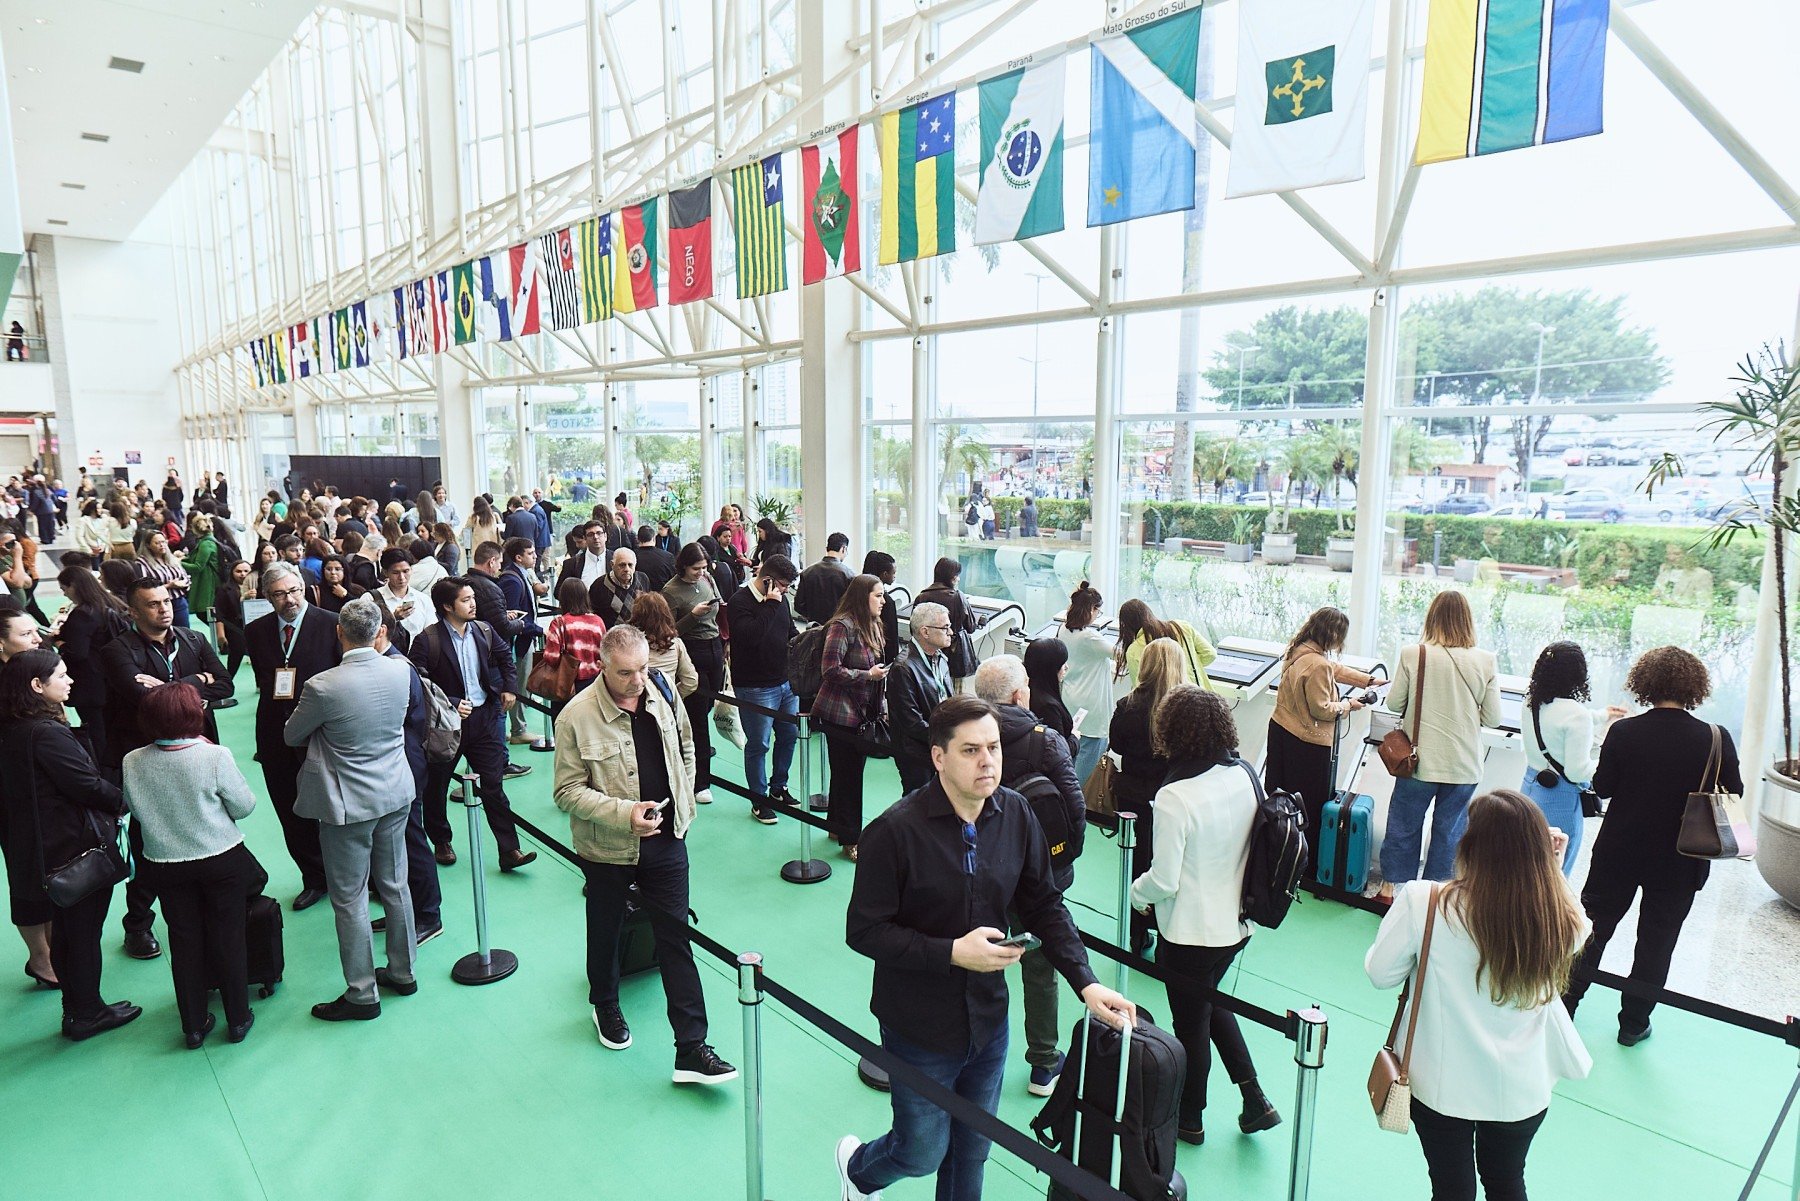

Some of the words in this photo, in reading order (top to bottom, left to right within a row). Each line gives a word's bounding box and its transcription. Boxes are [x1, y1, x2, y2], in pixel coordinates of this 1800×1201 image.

[1102, 23, 1122, 36] Mato
[1125, 11, 1155, 28] Grosso
[1158, 7, 1169, 17] do
[1171, 0, 1187, 12] Sul
[1007, 53, 1033, 70] Paraná
[906, 91, 929, 104] Sergipe
[810, 128, 824, 139] Santa
[824, 121, 846, 134] Catarina
[684, 245, 695, 287] NEGO
[1051, 842, 1065, 856] CAT
